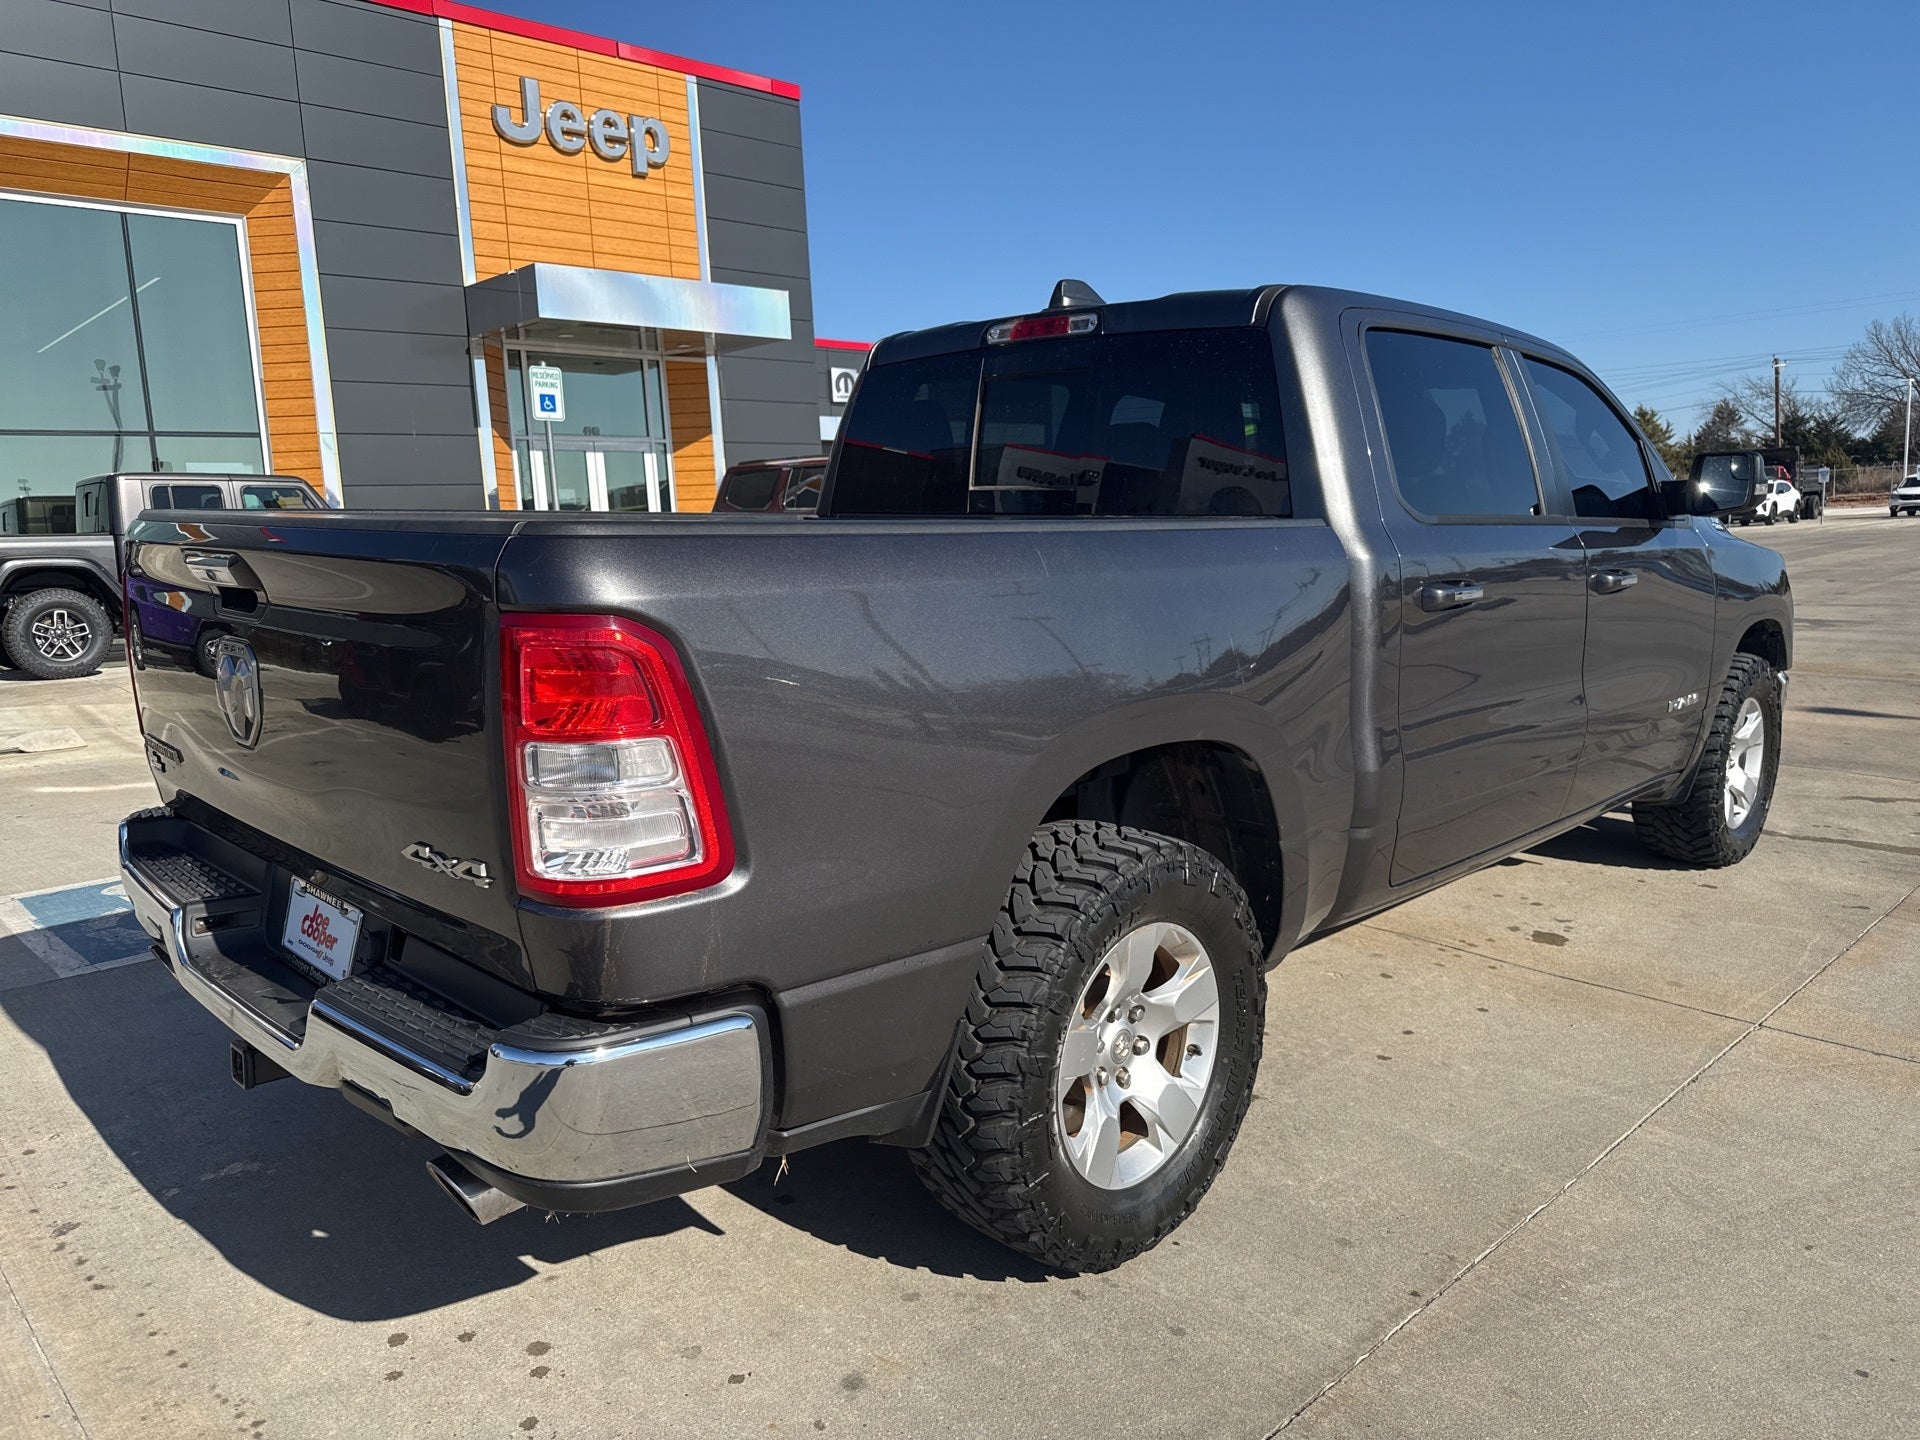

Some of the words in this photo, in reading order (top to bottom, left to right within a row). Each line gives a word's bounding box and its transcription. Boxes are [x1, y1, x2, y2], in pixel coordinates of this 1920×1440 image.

[492, 76, 670, 177] Jeep
[532, 372, 559, 380] RESERVED
[535, 380, 558, 389] PARKING
[223, 643, 245, 655] RAM
[305, 884, 343, 909] SHAWNEE
[310, 904, 330, 931] Joe
[322, 951, 335, 967] Jeep
